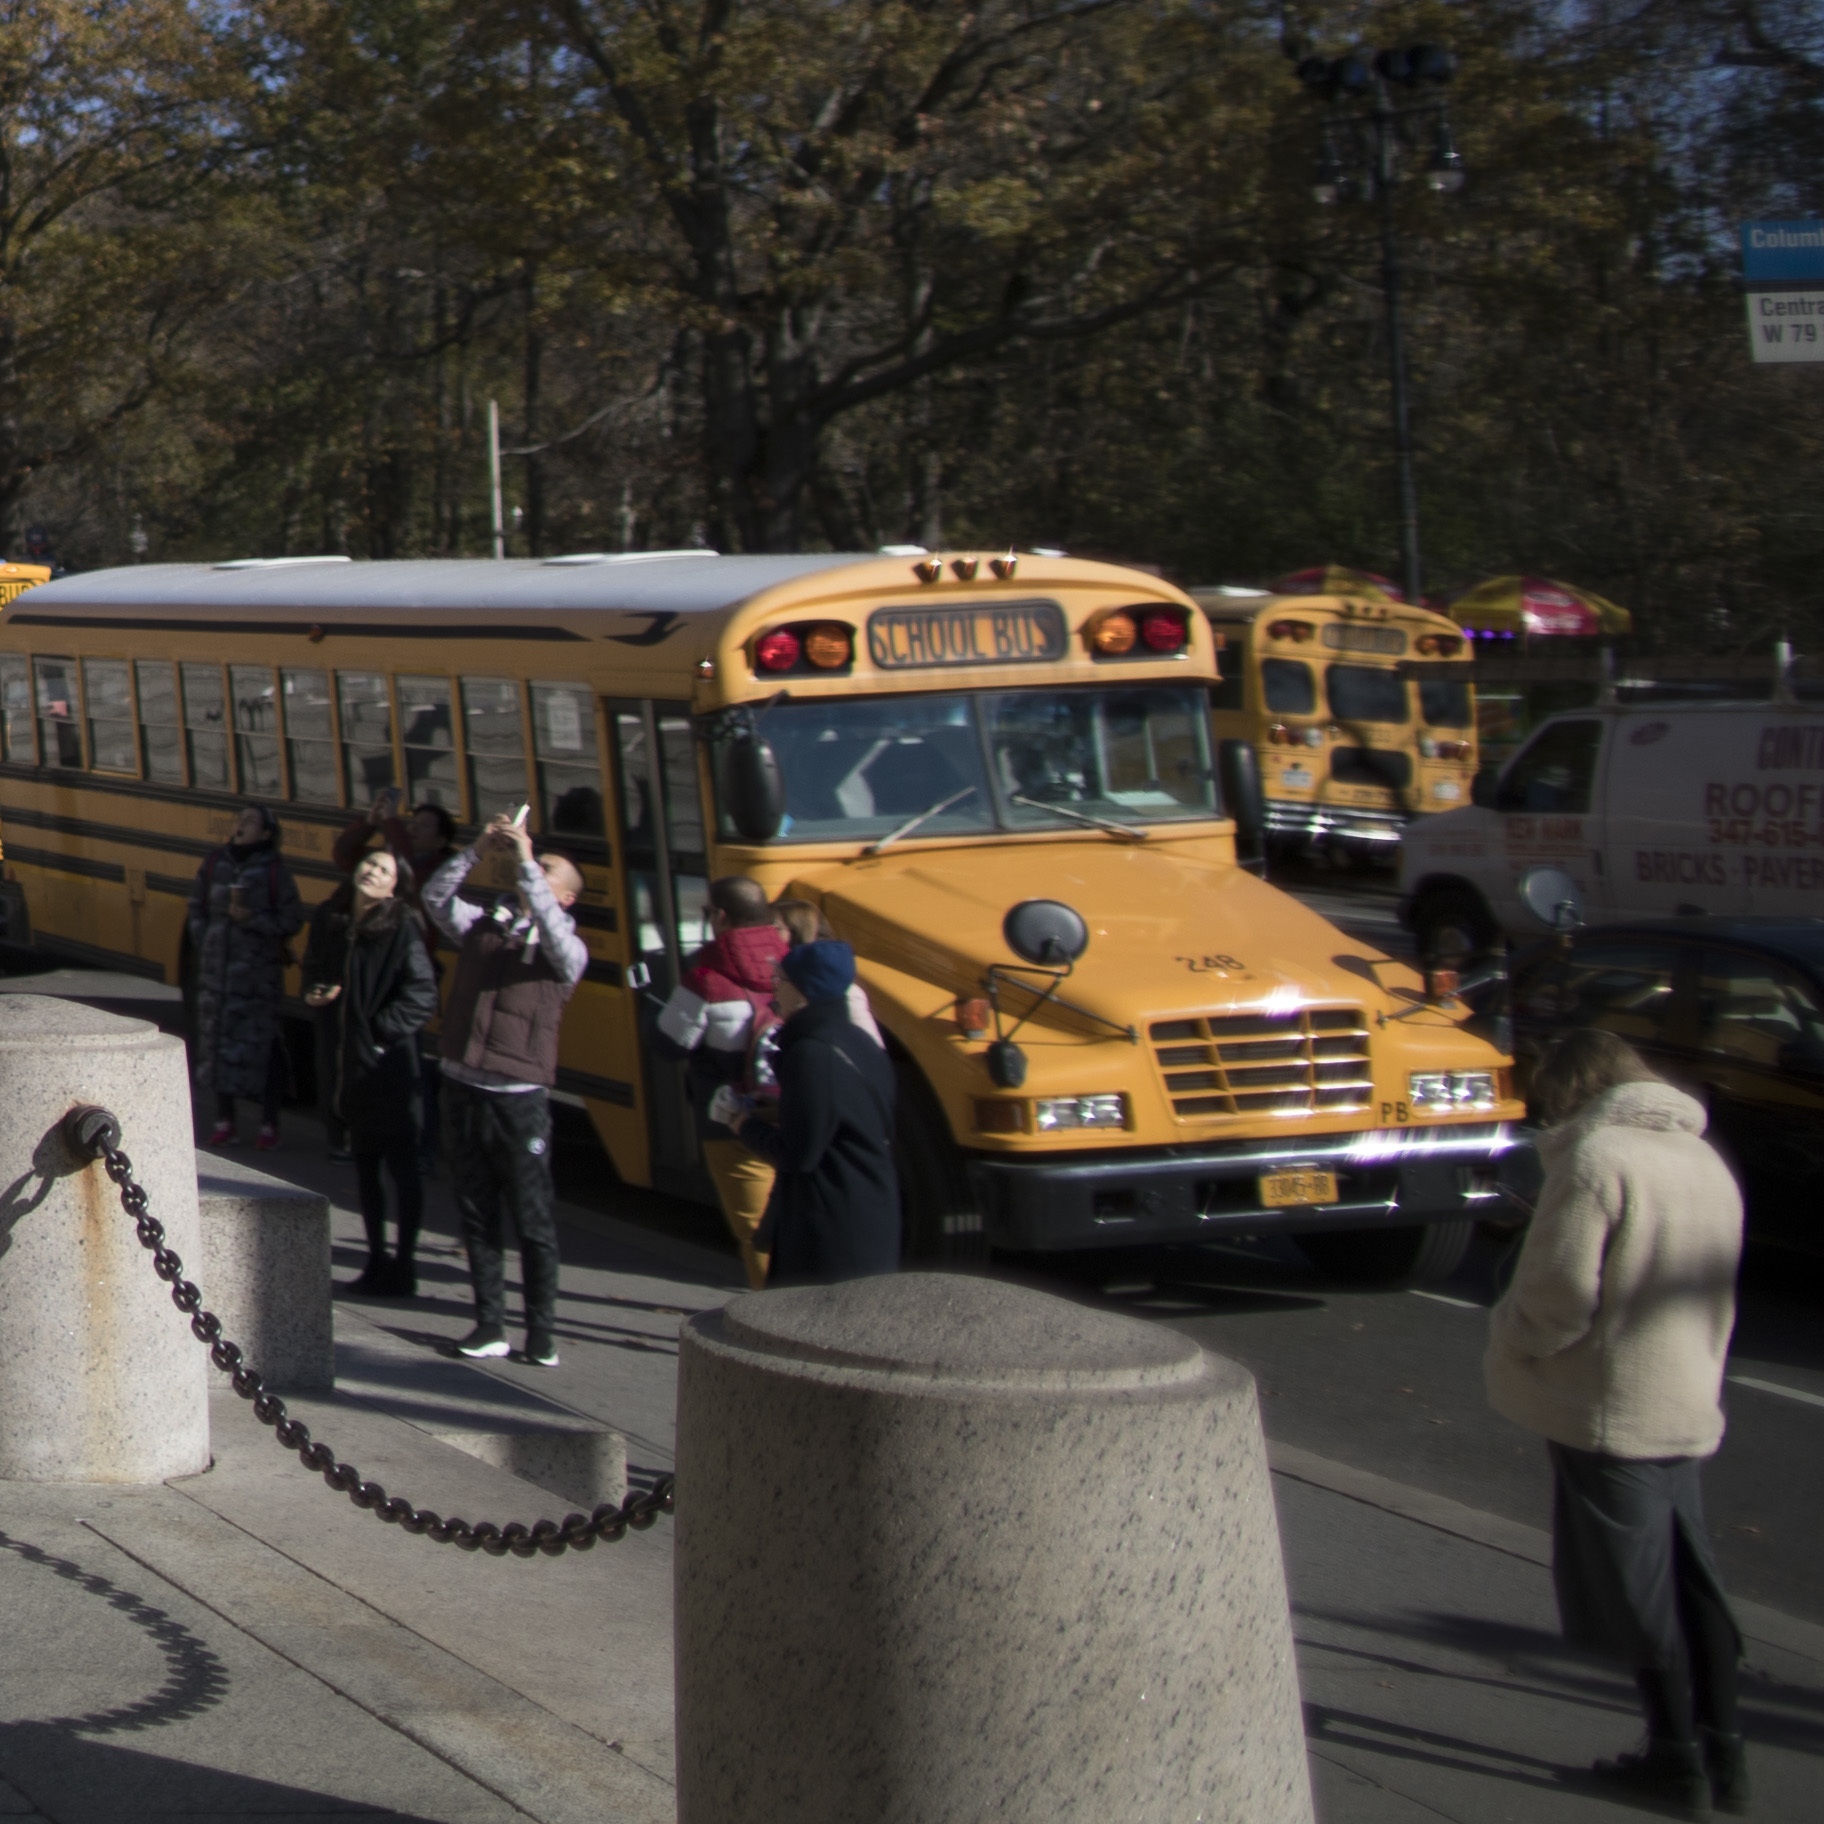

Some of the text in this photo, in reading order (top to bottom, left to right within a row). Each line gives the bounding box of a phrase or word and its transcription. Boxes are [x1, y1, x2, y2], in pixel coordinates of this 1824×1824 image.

[1764, 324, 1816, 343] W 79
[871, 606, 1049, 663] SCHOOL BUS
[1709, 818, 1824, 847] 347-615-
[1635, 850, 1726, 886] BRICKS
[1175, 954, 1246, 973] 248
[1381, 1102, 1408, 1122] PB
